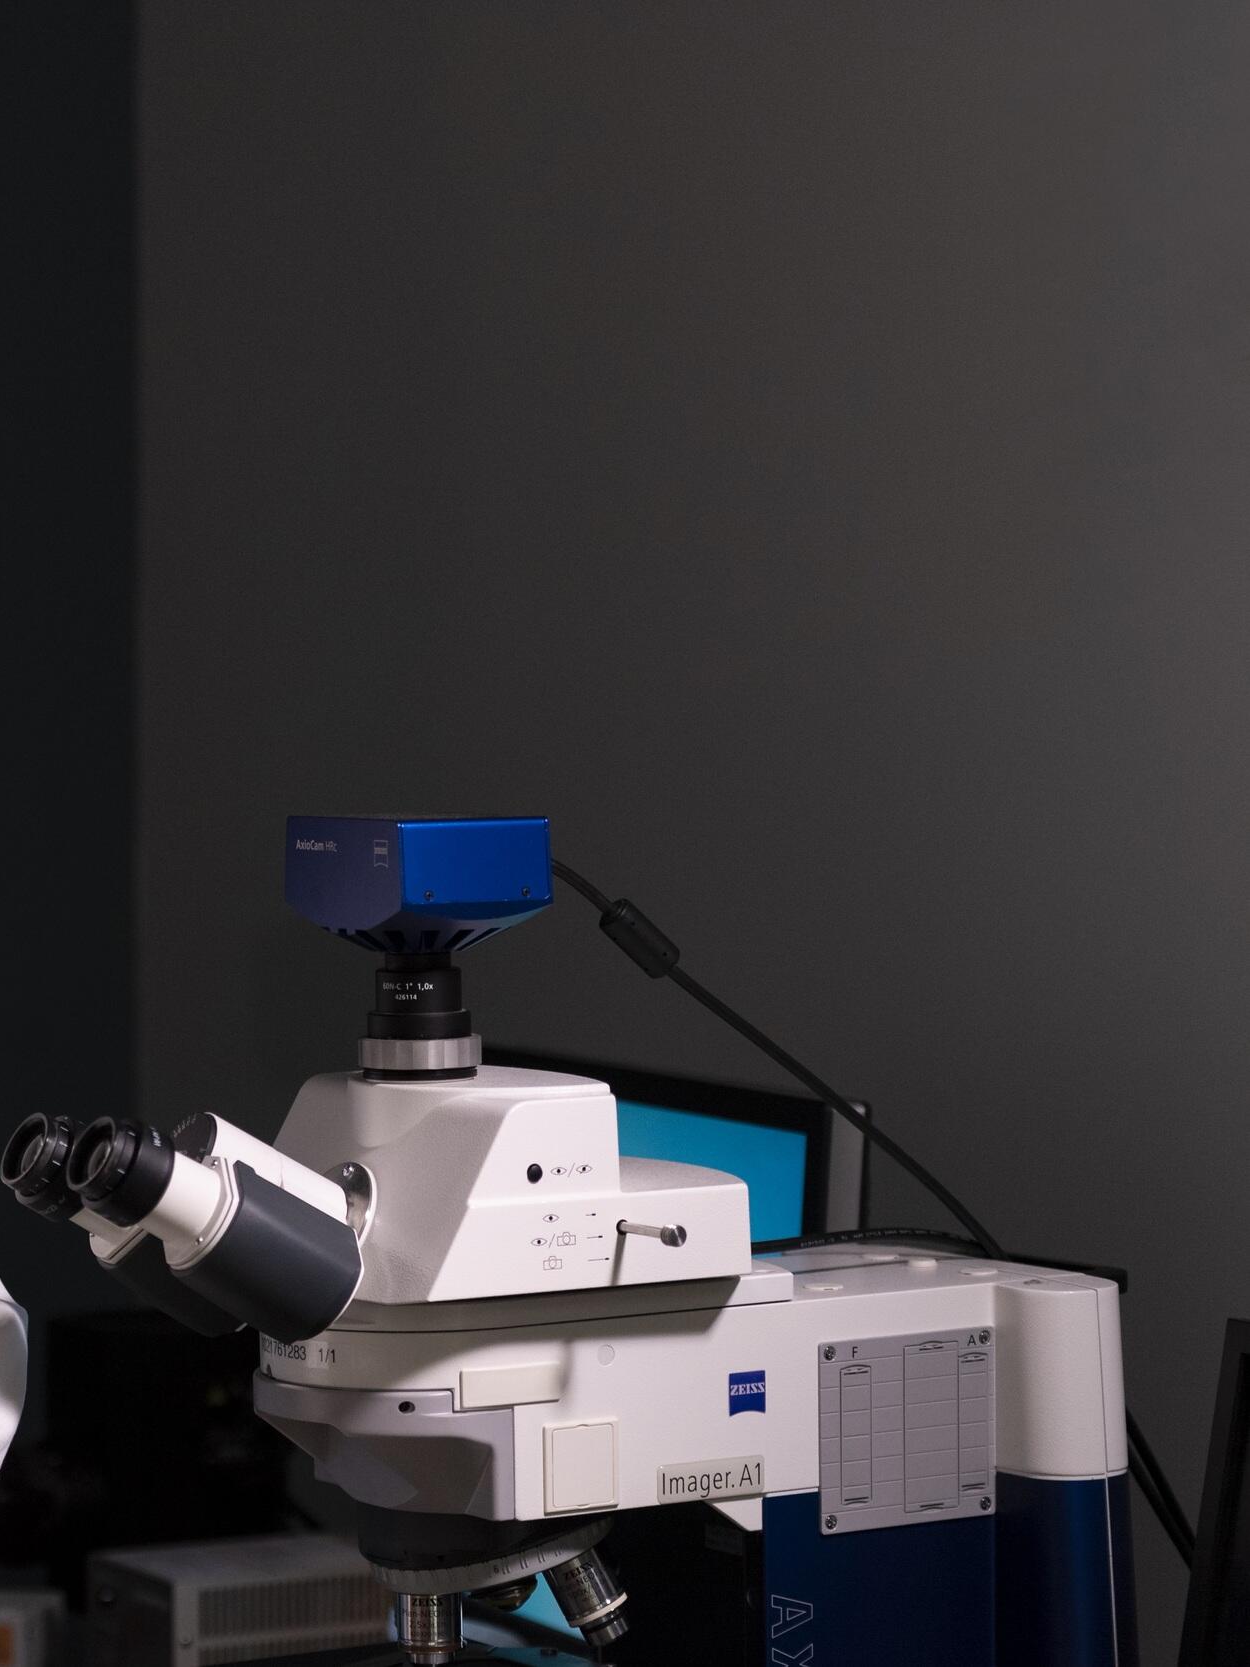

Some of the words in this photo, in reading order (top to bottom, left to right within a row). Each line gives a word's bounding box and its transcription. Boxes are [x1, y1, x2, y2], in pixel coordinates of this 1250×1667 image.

[296, 839, 324, 851] AxioCam
[395, 993, 418, 1001] 426114
[966, 1334, 977, 1346] A
[318, 1348, 336, 1363] 1/1
[851, 1346, 859, 1358] F
[730, 1382, 765, 1396] ZEISS
[412, 1598, 444, 1607] ZEISS
